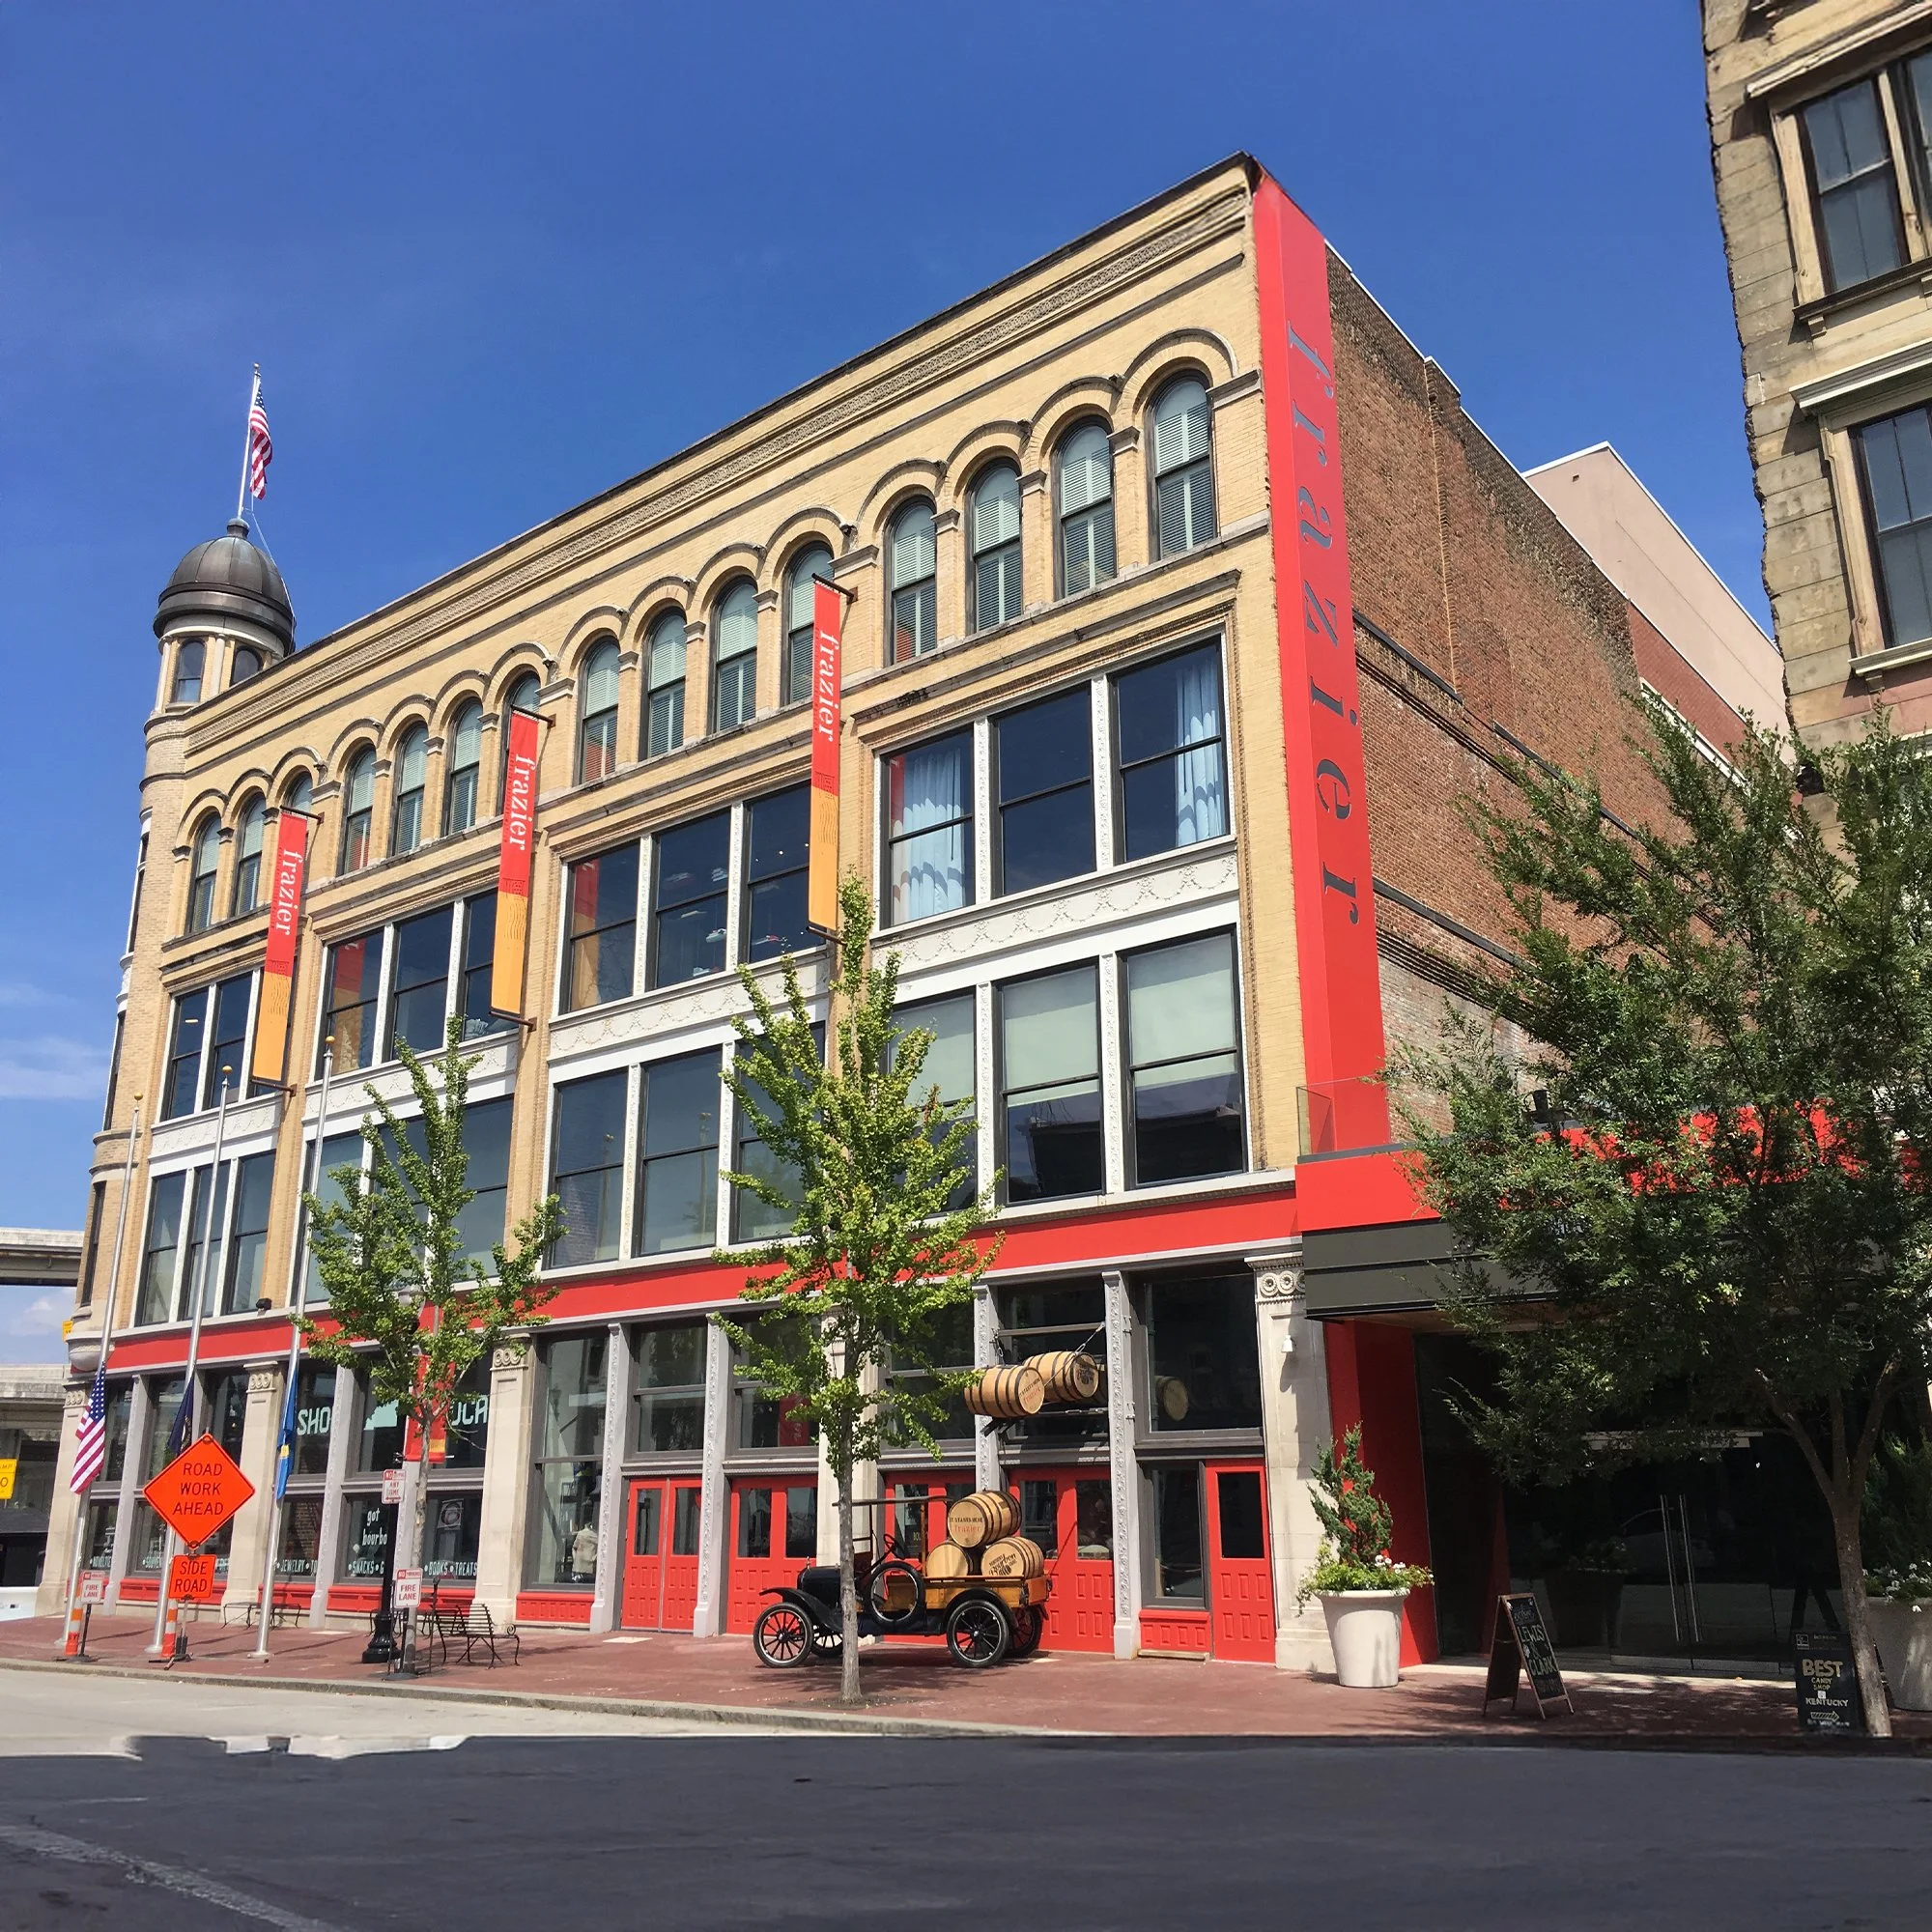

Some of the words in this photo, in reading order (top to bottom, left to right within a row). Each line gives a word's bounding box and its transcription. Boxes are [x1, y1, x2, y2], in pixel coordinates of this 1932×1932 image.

[1287, 319, 1358, 924] frazier
[818, 630, 839, 742] frazier
[508, 753, 536, 851] frazier
[275, 849, 303, 936] frazier
[183, 1463, 223, 1476] ROAD
[181, 1482, 221, 1495] WORK
[173, 1502, 223, 1515] AHEAD
[367, 1507, 380, 1526] got
[180, 1561, 208, 1575] SIDE
[280, 1559, 305, 1573] JEWELRY
[353, 1560, 374, 1574] SNACKS
[429, 1562, 448, 1576] BOOKS
[455, 1561, 477, 1576] TREATS
[175, 1578, 207, 1592] ROAD
[1518, 1624, 1546, 1642] LEWIS
[1527, 1657, 1557, 1676] CLARK
[1802, 1659, 1843, 1678] BEST
[1805, 1697, 1849, 1707] KENTUCKY
